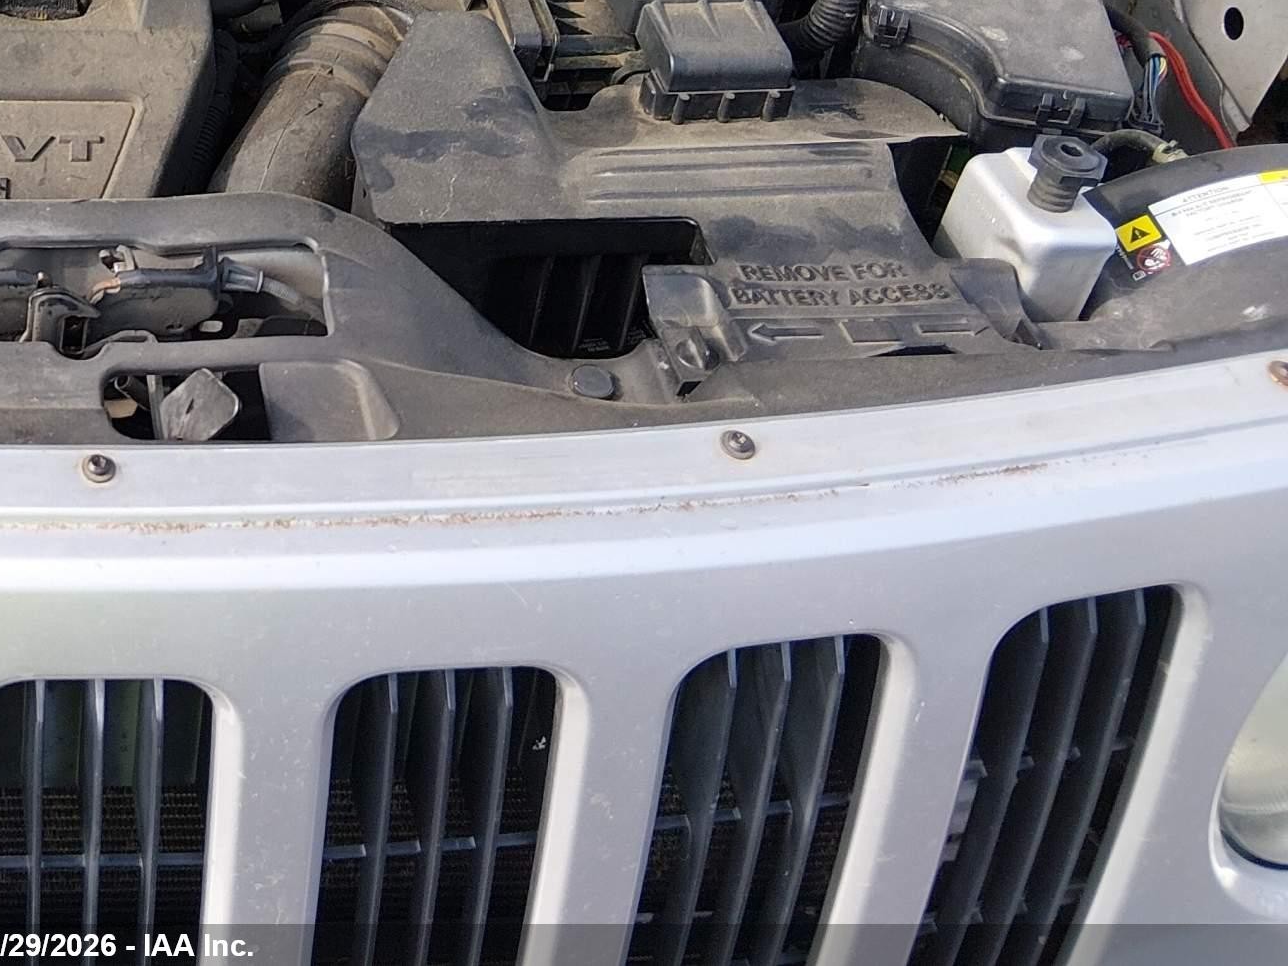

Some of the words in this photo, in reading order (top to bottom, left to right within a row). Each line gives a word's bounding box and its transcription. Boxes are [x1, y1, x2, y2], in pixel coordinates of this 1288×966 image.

[736, 264, 850, 283] REMOVE
[850, 262, 909, 281] FOR
[728, 286, 842, 308] BATTERY
[848, 282, 952, 307] ACCESS
